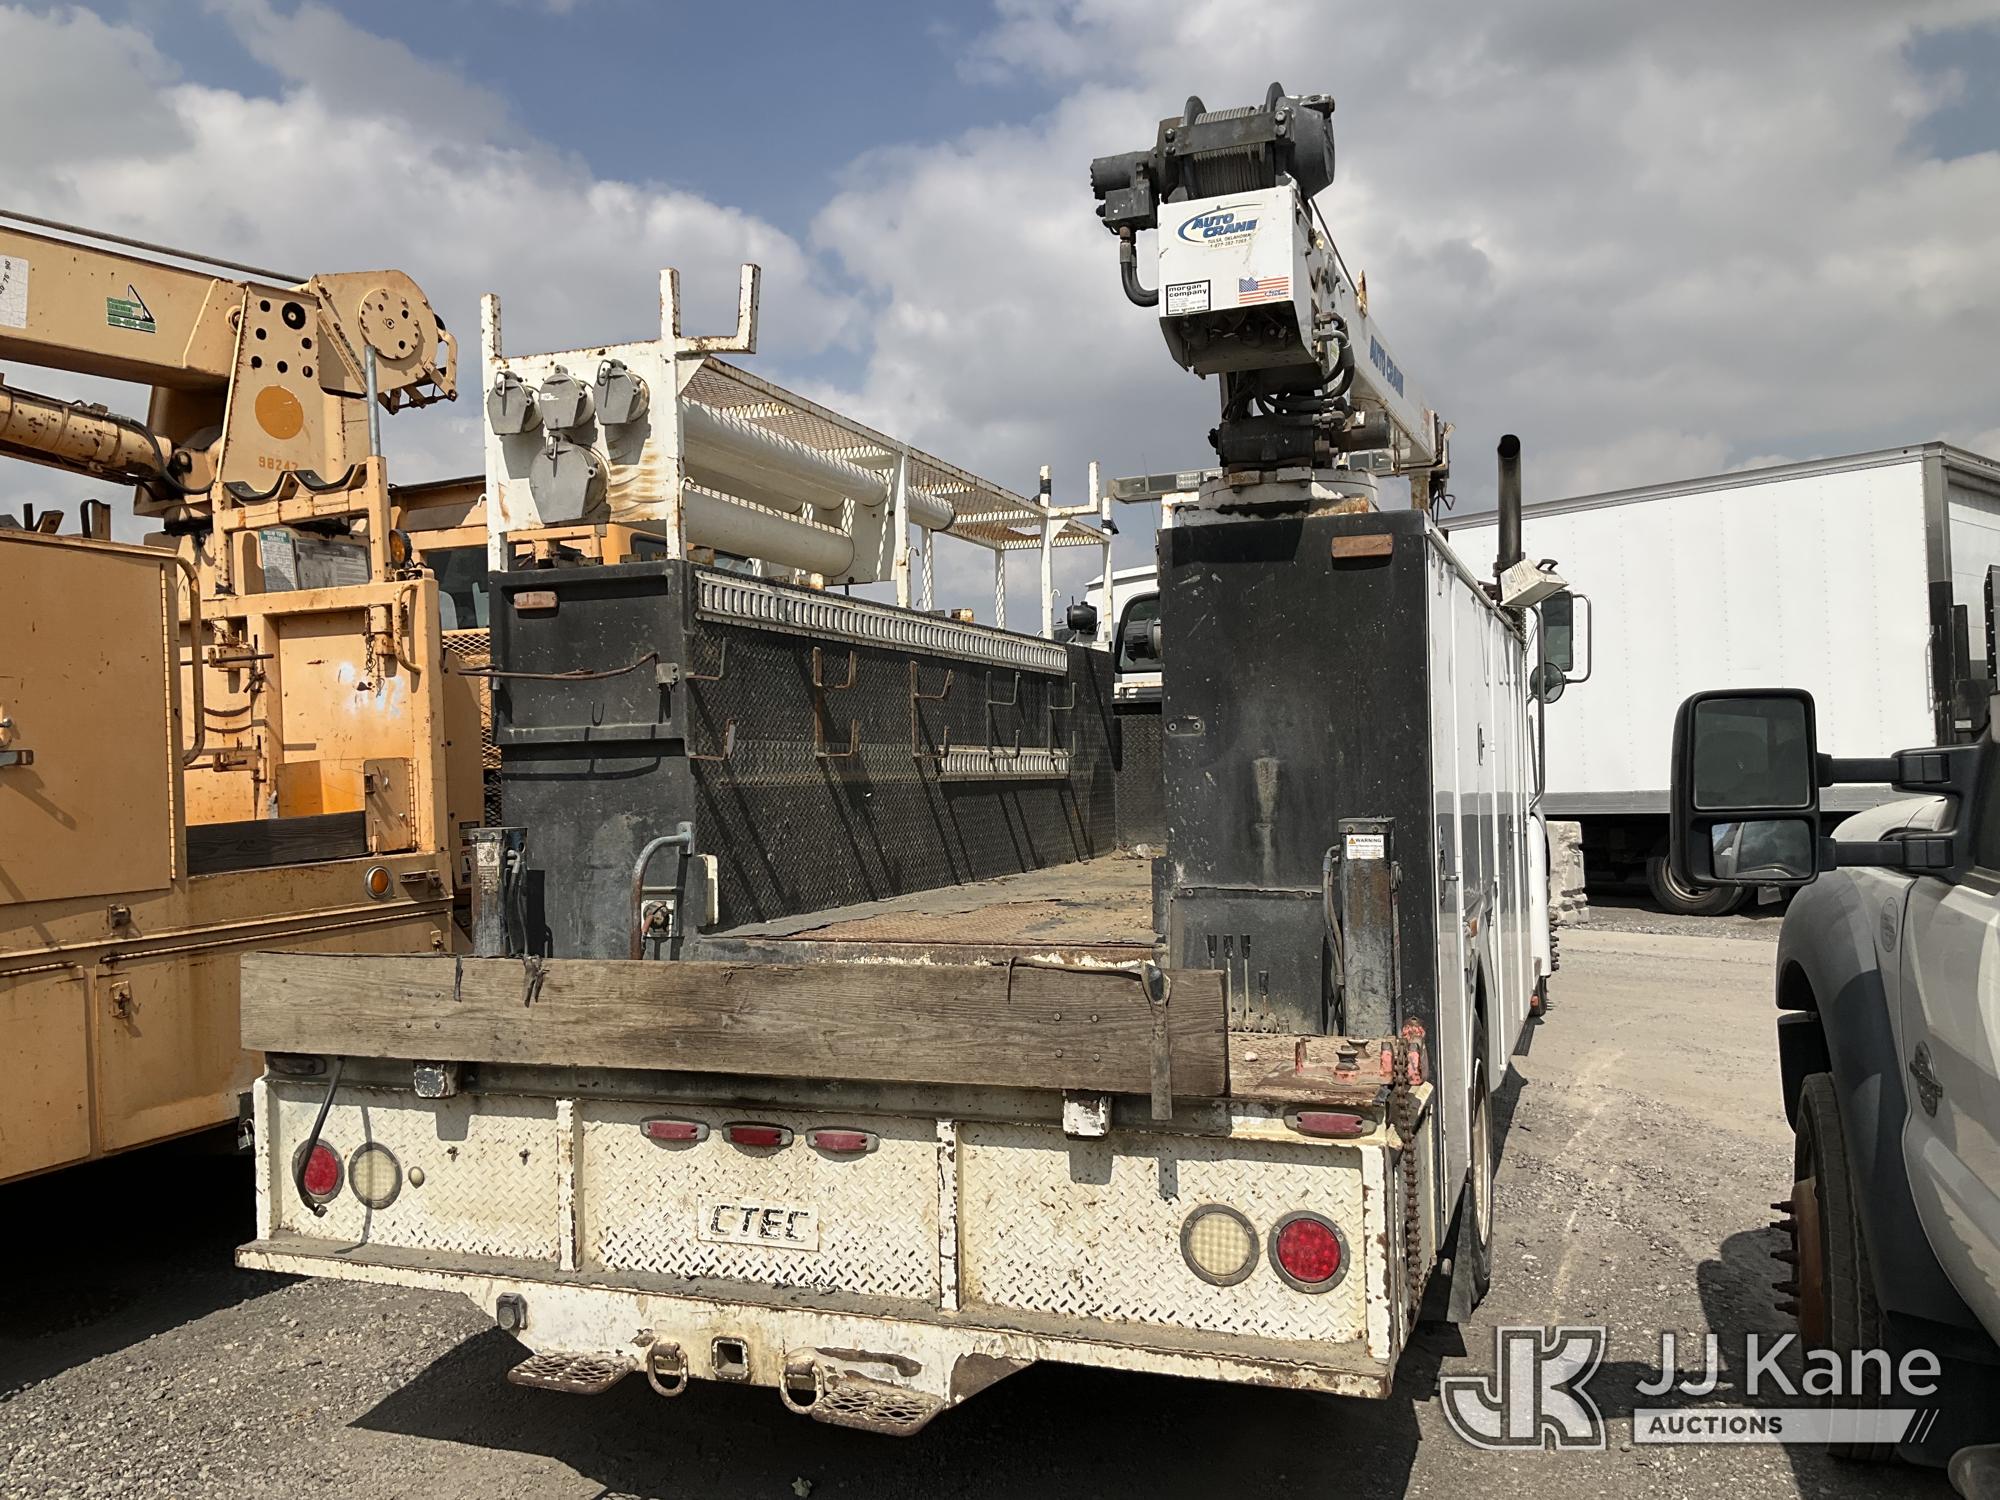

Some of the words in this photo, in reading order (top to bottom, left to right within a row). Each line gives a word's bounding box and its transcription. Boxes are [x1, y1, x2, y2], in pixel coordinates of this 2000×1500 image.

[1191, 213, 1234, 230] AUTO
[1203, 219, 1258, 238] CRANE
[1169, 284, 1202, 292] morgan
[1169, 289, 1207, 297] company
